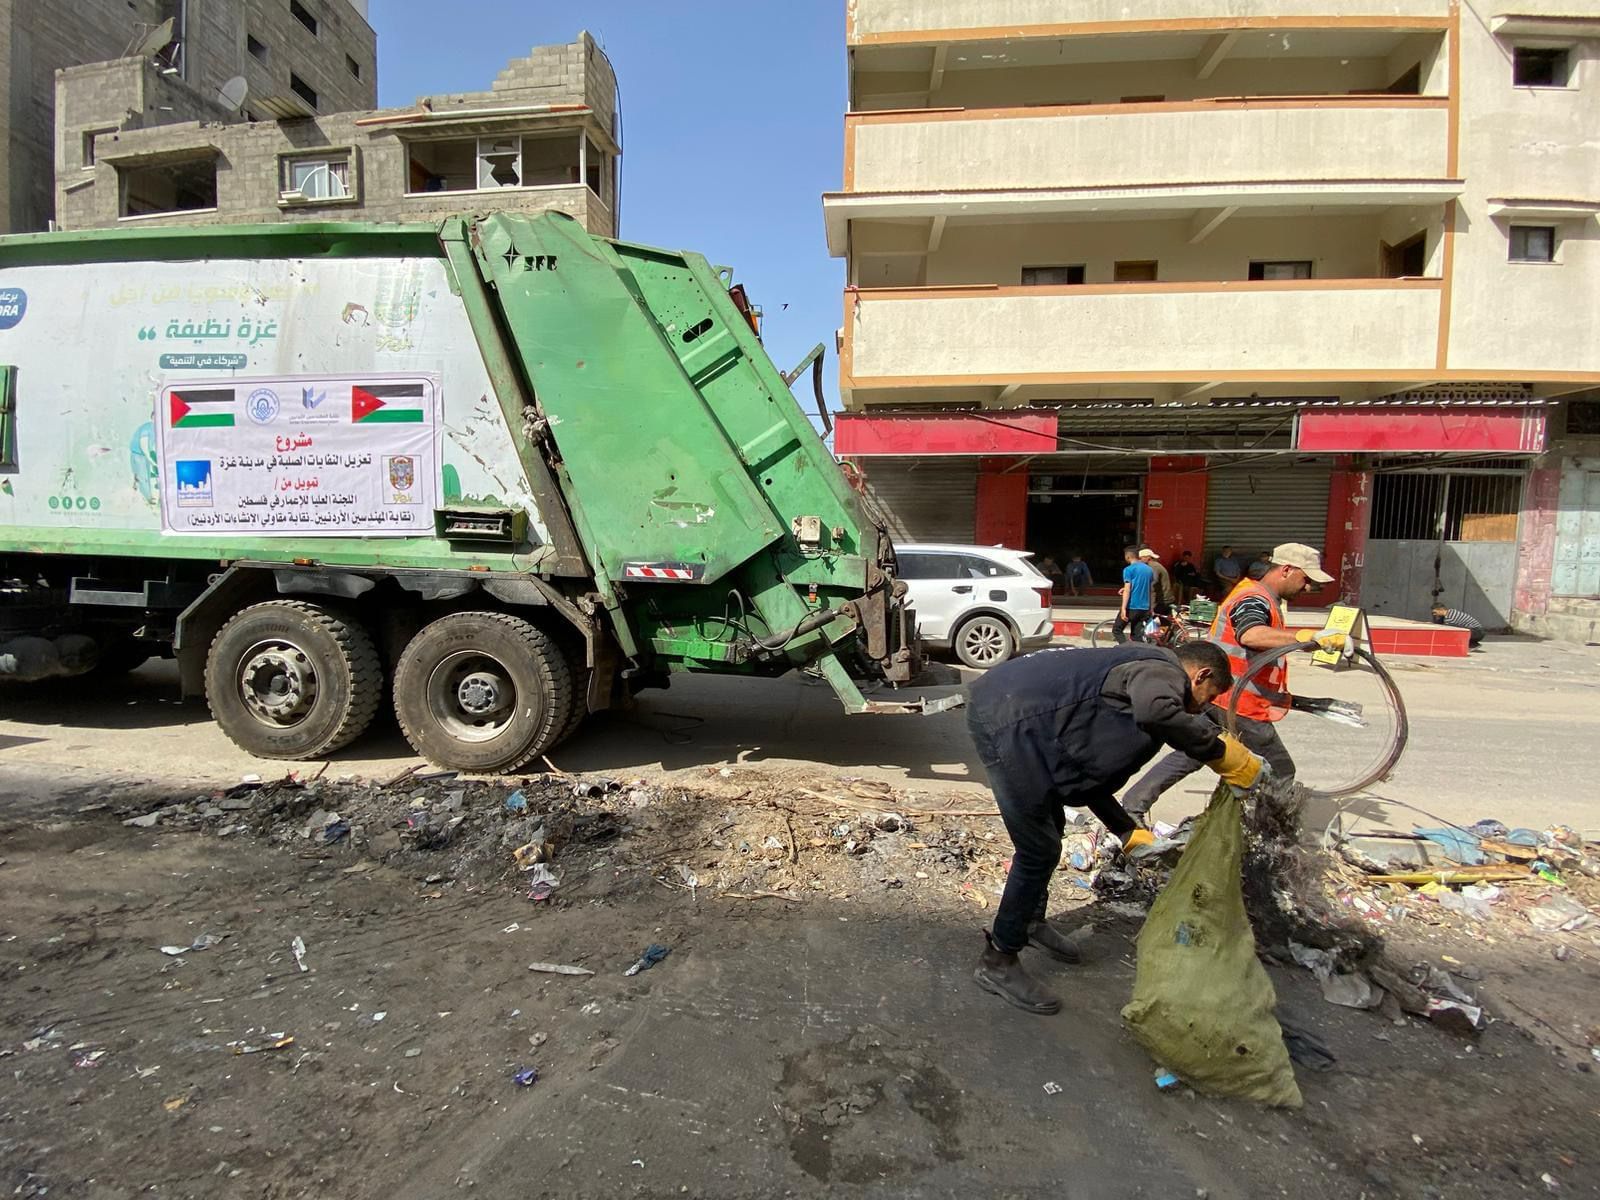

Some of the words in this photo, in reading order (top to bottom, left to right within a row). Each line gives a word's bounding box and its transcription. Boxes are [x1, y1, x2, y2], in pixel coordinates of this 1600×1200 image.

[165, 318, 230, 344] نظيفة
[237, 317, 277, 345] غزة
[196, 357, 212, 368] في
[276, 431, 313, 452] مشروع
[219, 457, 237, 471] غزة
[239, 456, 264, 470] مدينة
[267, 456, 277, 473] في
[279, 455, 306, 469] الصلبة
[307, 455, 342, 469] النفايات
[345, 453, 371, 469] تعزيل
[281, 477, 292, 491] من
[294, 477, 319, 491] تمويل
[238, 494, 268, 508] فلسطين
[269, 495, 278, 511] في
[312, 494, 331, 508] العليا
[333, 494, 357, 508] اللجنة
[261, 513, 286, 528] مقاولي
[288, 511, 309, 526] نقابة
[351, 511, 388, 525] المهندسين
